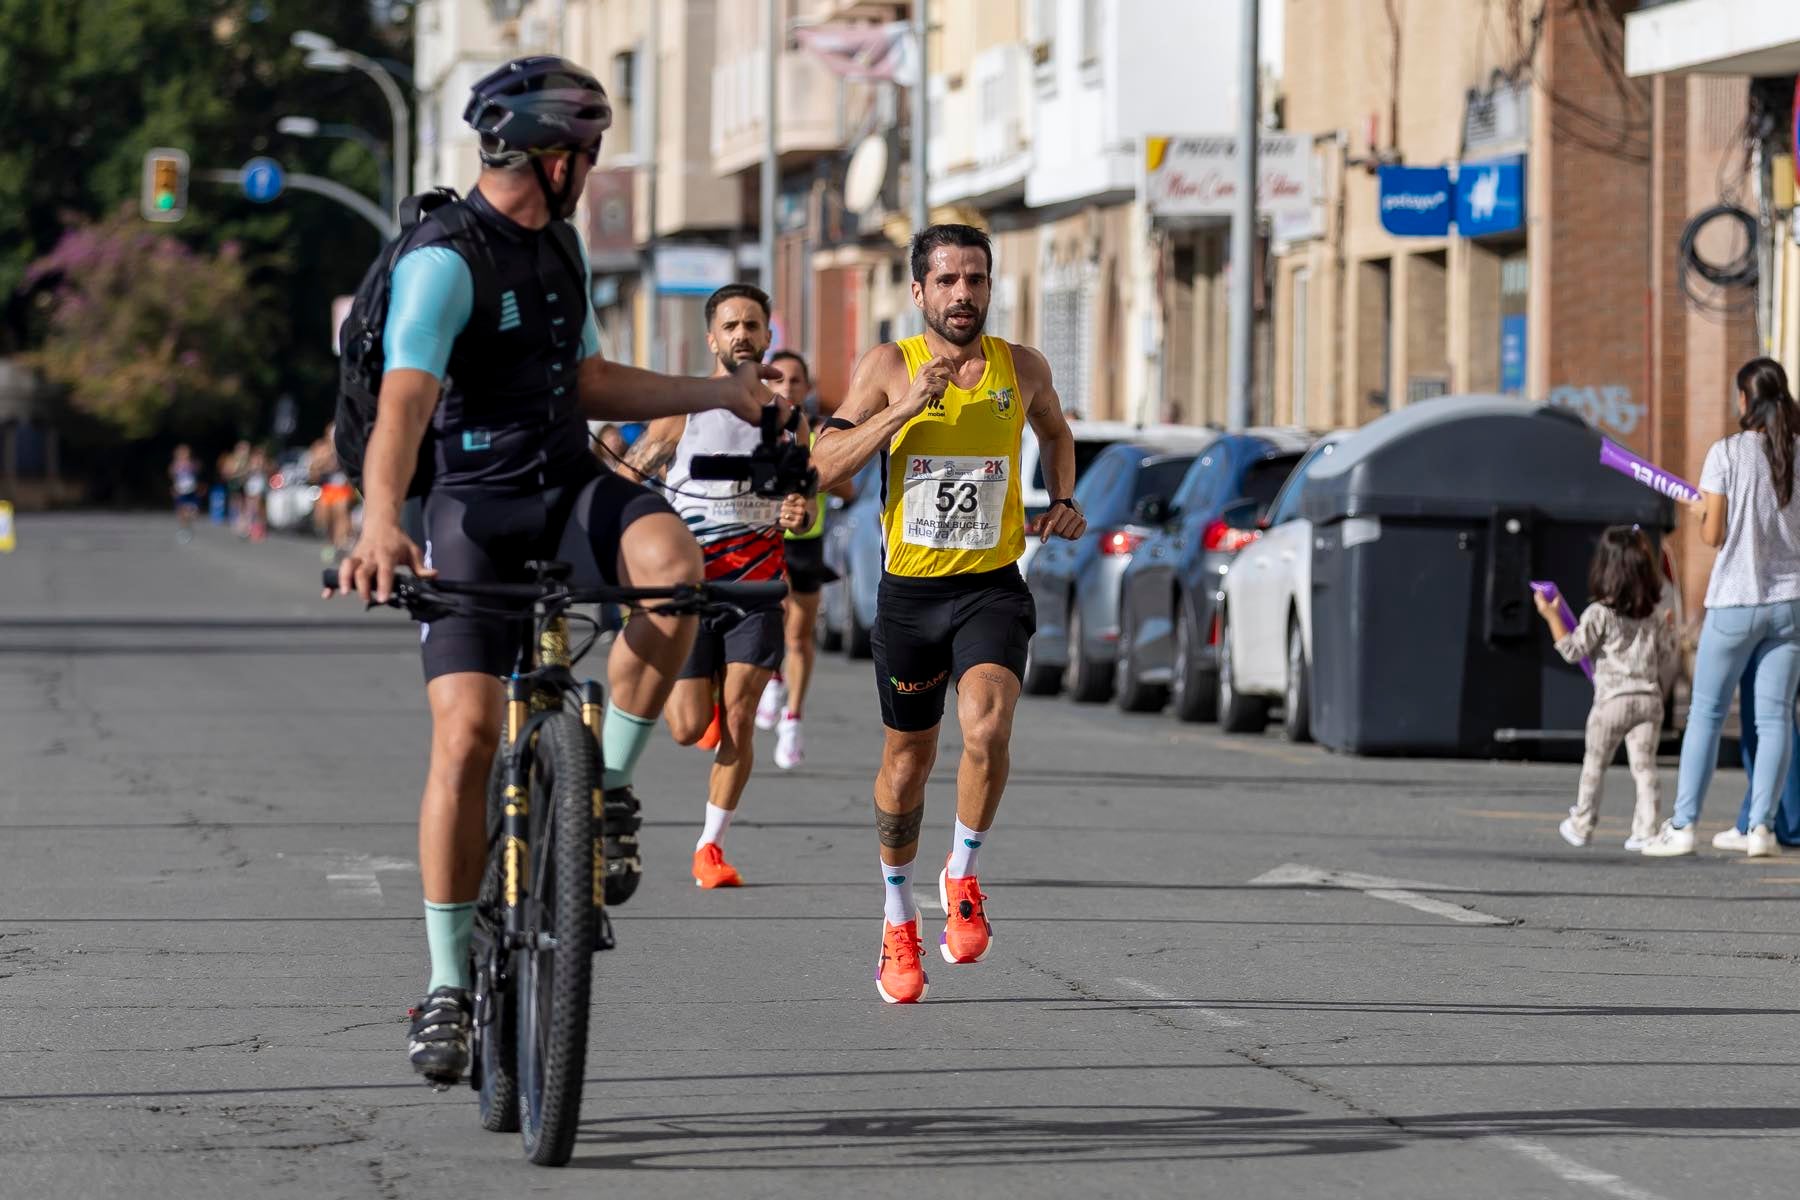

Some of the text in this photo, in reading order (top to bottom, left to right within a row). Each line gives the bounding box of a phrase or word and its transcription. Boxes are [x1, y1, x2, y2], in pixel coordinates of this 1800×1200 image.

[912, 459, 932, 473] 2K
[985, 460, 1003, 474] 2K
[935, 482, 978, 513] 53
[908, 523, 949, 539] Huelva
[953, 521, 989, 530] BUCETA
